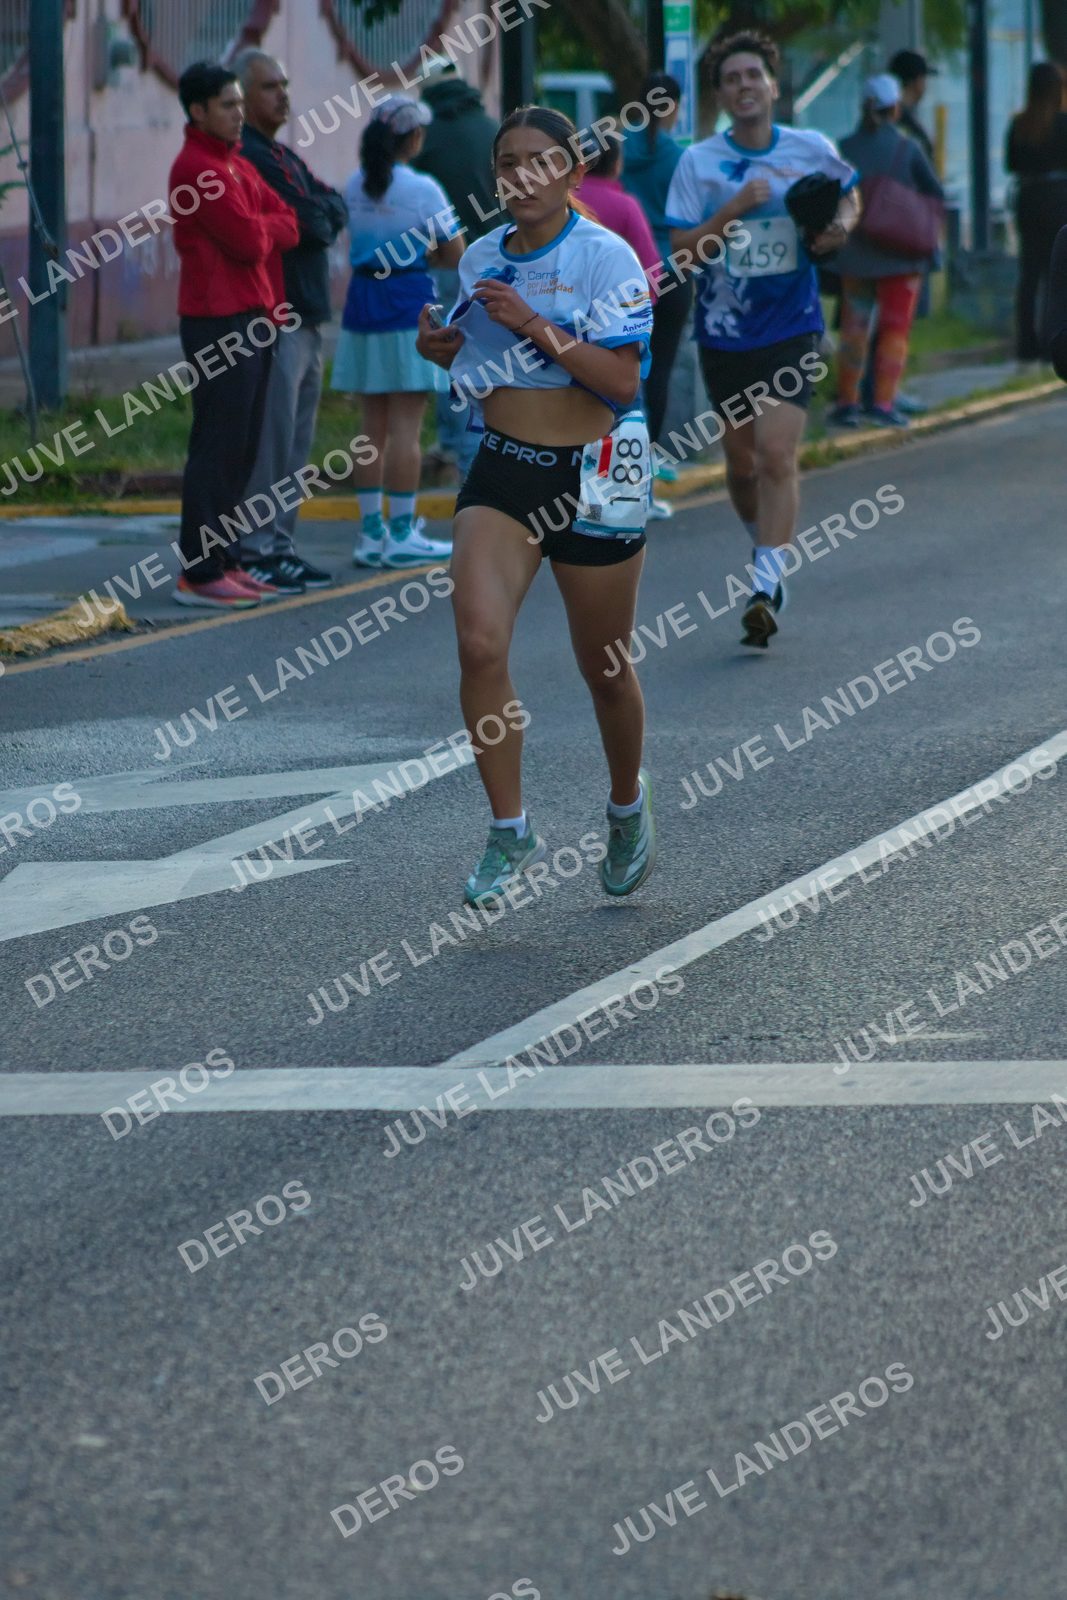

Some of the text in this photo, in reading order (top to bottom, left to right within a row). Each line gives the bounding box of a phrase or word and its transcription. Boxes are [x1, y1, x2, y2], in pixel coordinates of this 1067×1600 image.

[738, 241, 788, 269] 459
[502, 440, 558, 467] PRO
[610, 437, 643, 507] 188
